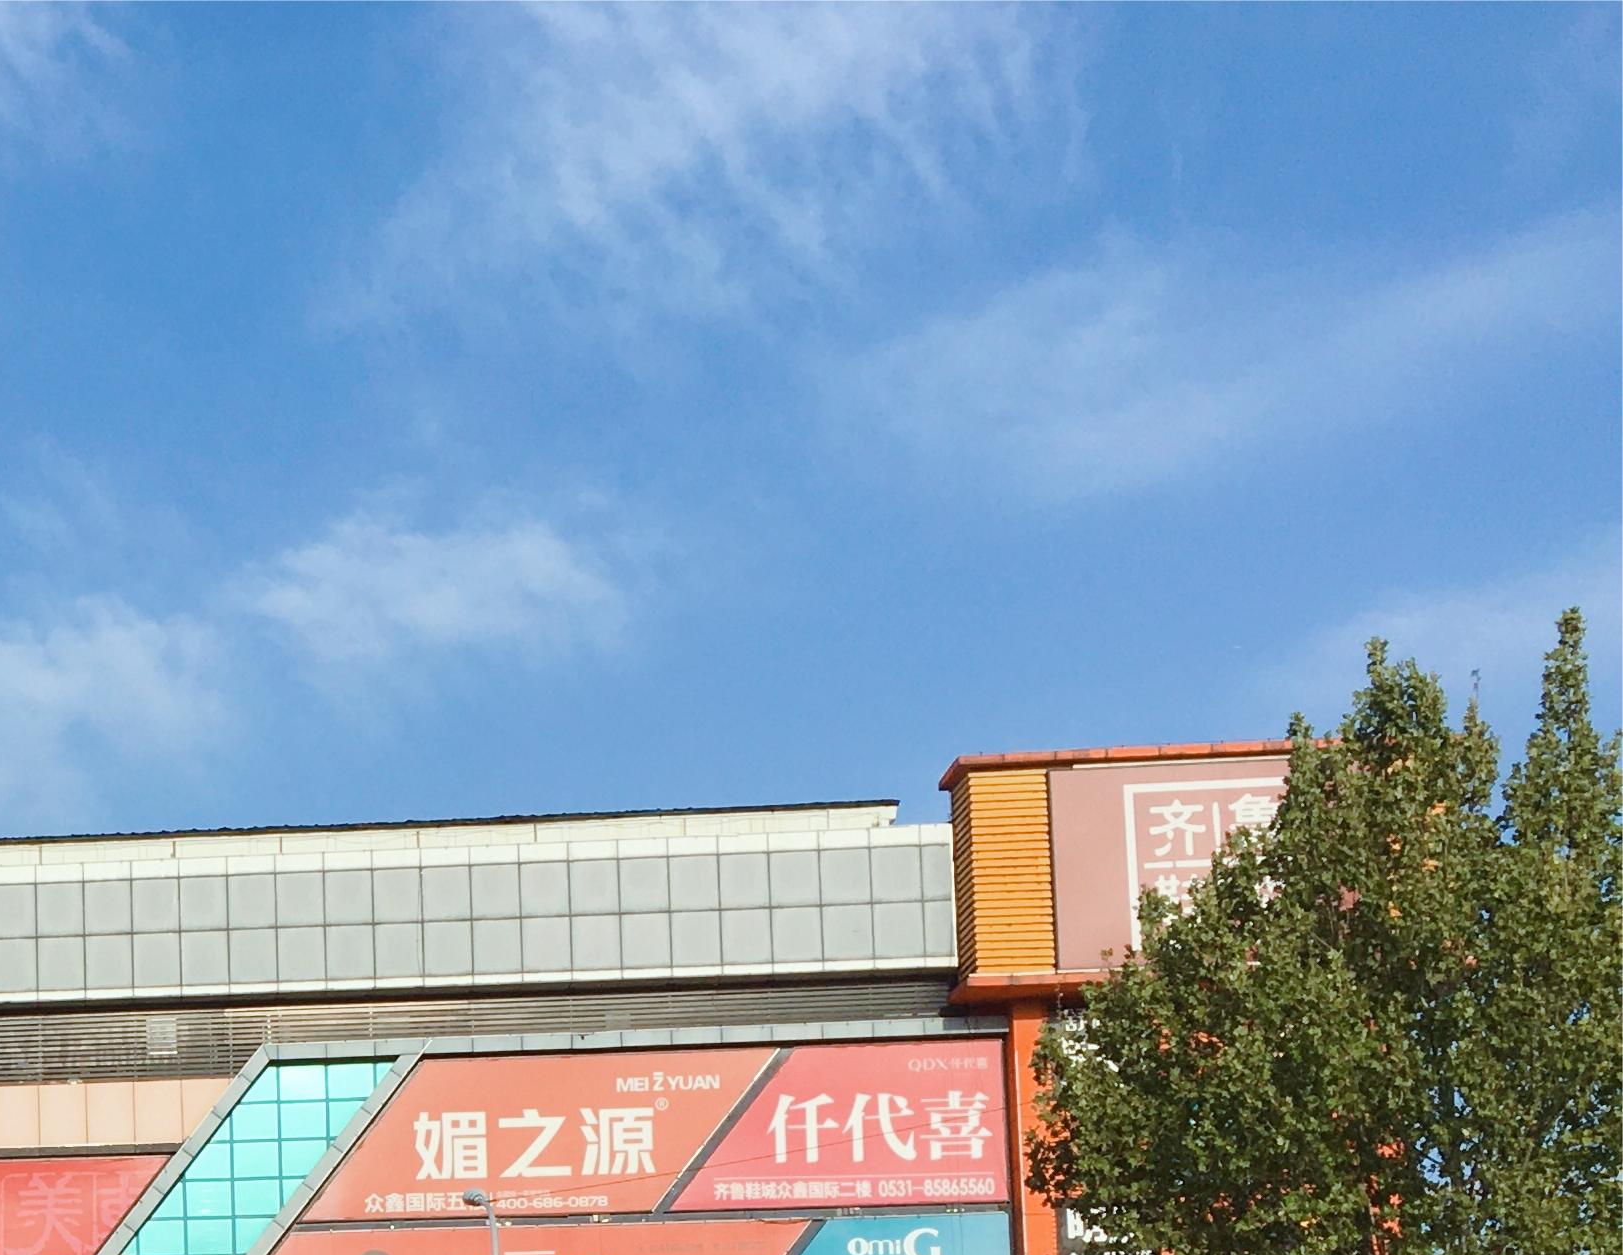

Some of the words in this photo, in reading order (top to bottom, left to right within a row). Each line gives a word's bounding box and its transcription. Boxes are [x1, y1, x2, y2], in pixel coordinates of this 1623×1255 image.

[413, 1107, 657, 1181] 媚之源
[766, 1090, 993, 1164] 仟代喜
[364, 1191, 485, 1213] 众鑫国际五
[496, 1196, 608, 1210] 400-686-0878
[878, 1177, 995, 1197] 0531-85865560
